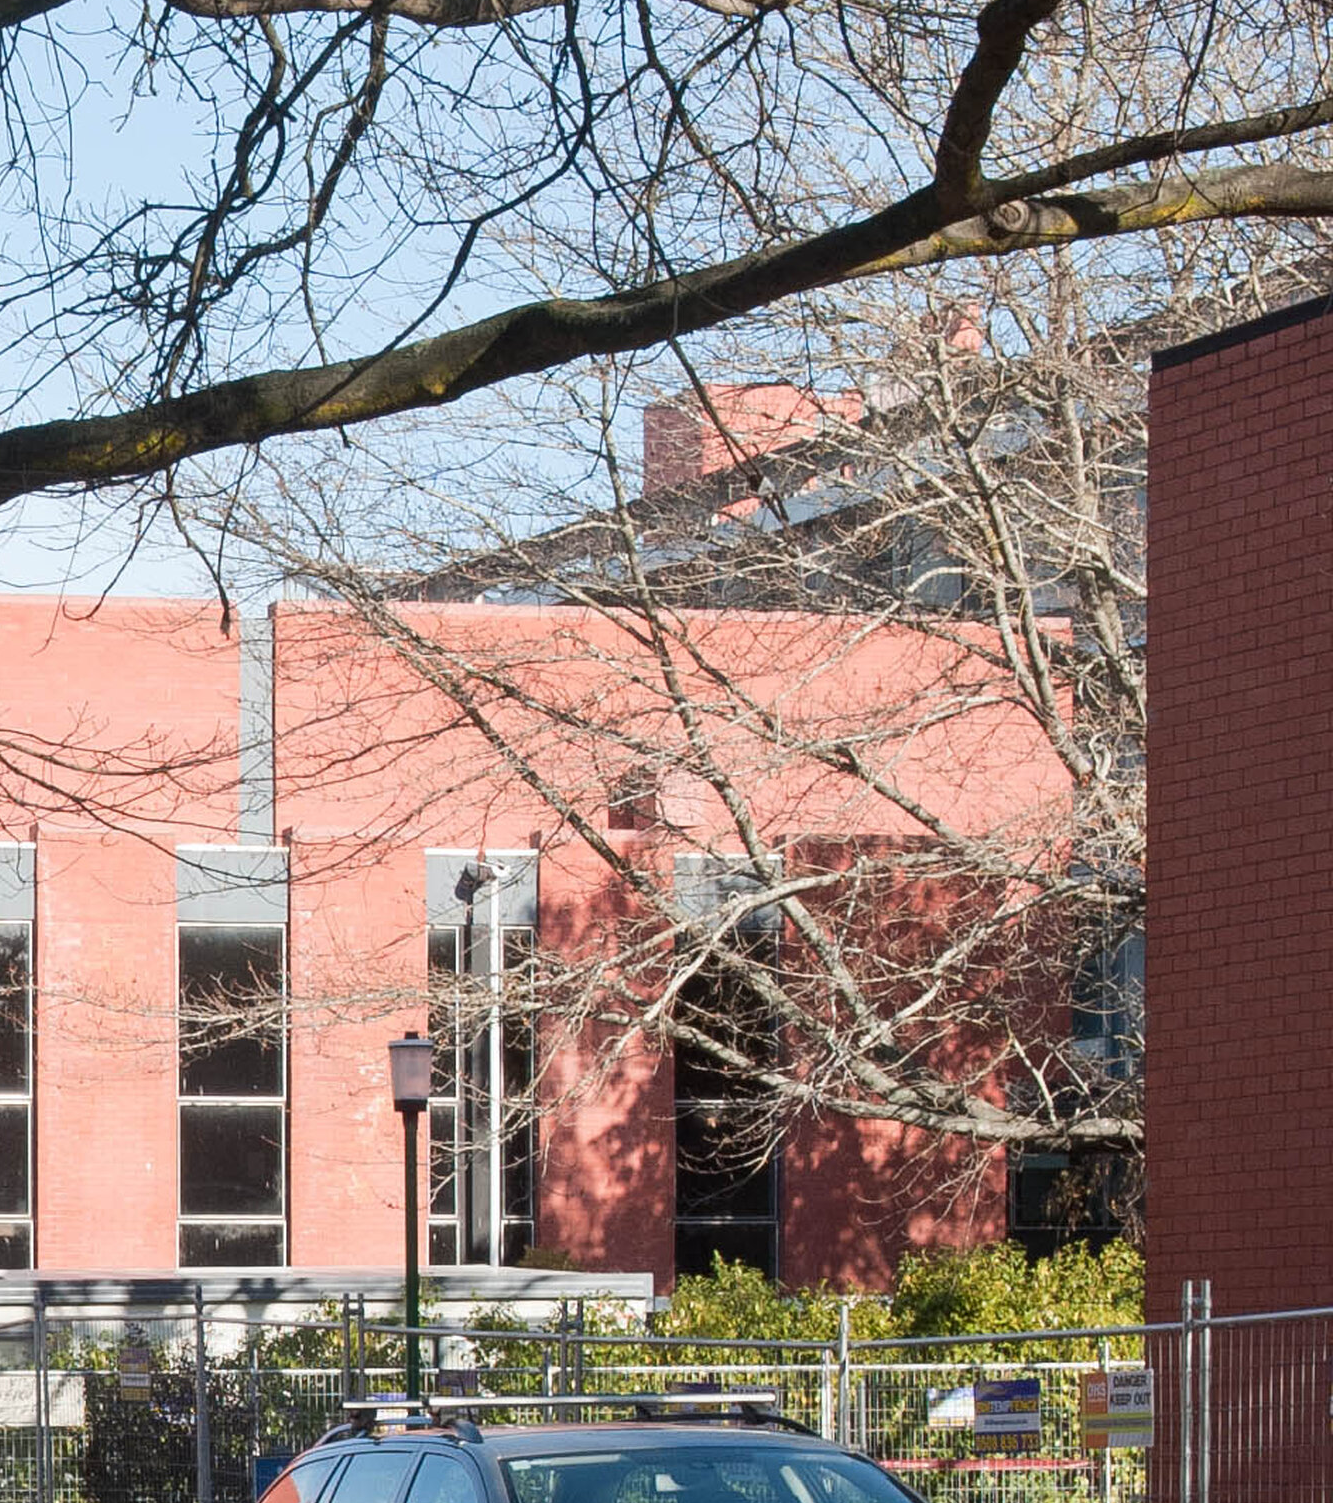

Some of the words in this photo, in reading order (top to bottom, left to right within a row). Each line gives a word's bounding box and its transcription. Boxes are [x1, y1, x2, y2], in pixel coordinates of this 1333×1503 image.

[1113, 1375, 1147, 1388] DANGER
[1110, 1393, 1132, 1406] KEEP
[1134, 1392, 1151, 1405] OUT
